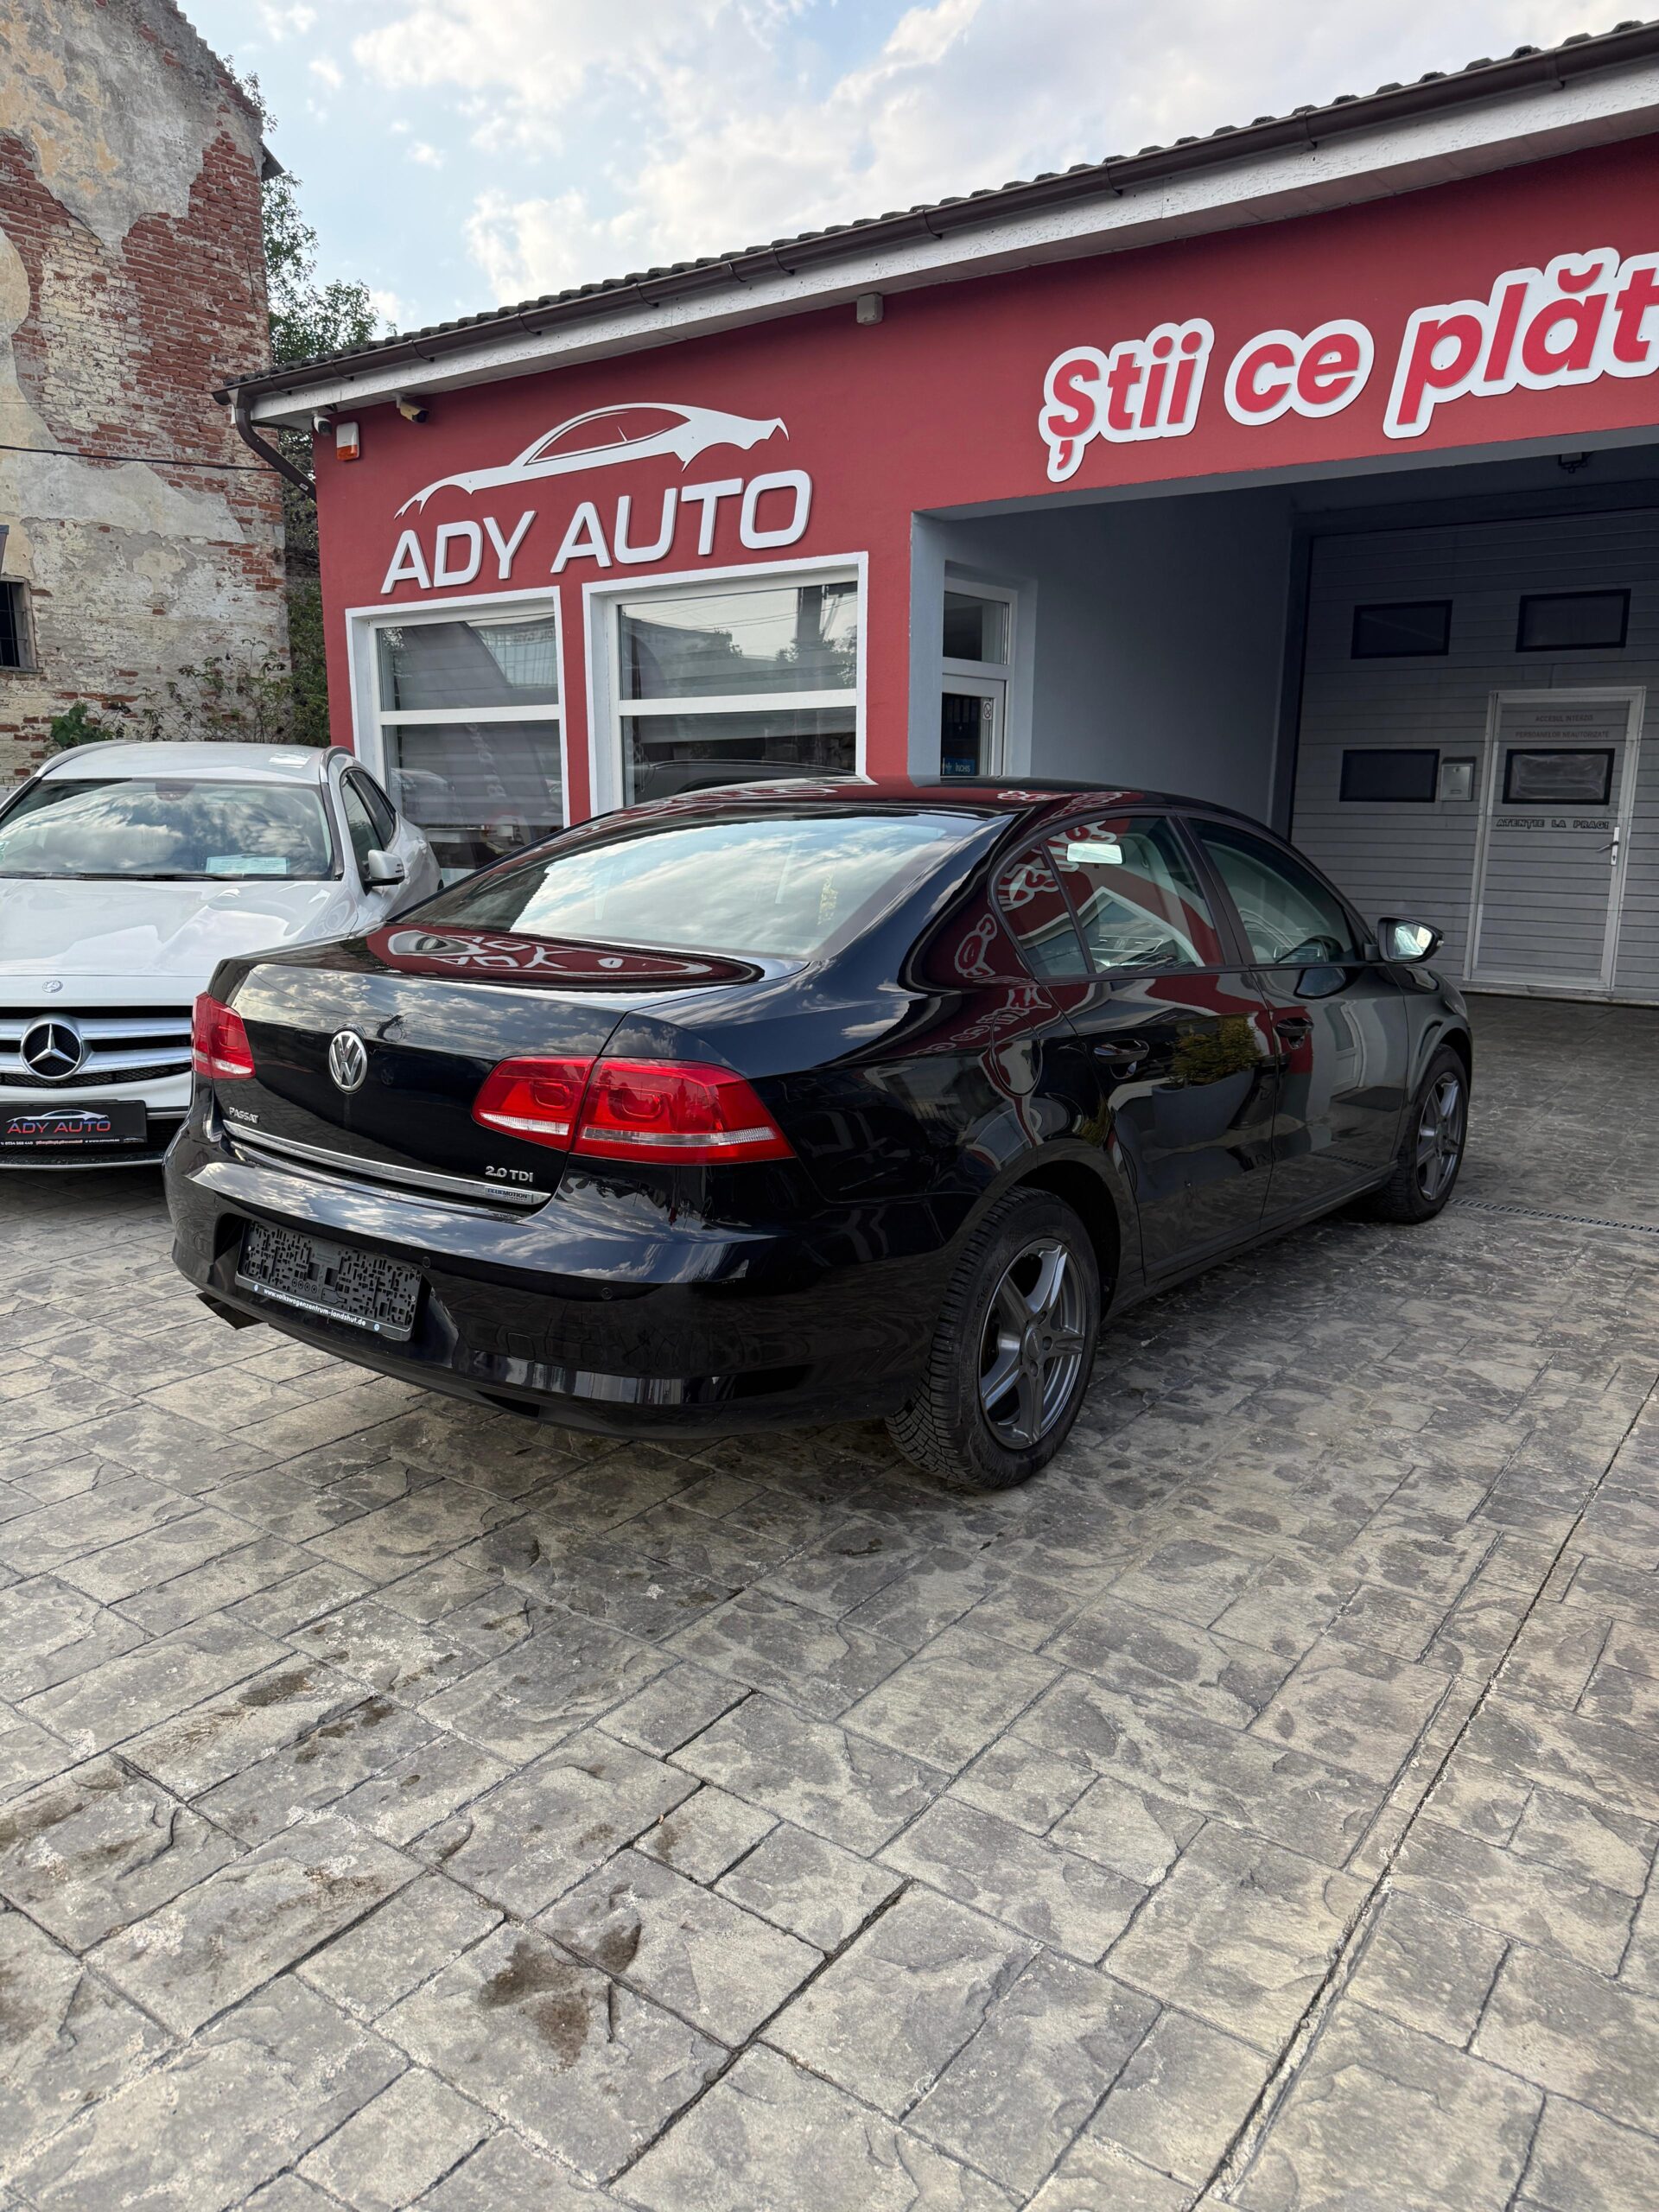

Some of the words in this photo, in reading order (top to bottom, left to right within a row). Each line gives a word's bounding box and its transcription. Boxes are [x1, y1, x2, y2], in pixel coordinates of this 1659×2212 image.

[1046, 328, 1205, 472] Știi
[1233, 330, 1363, 415] ce
[380, 510, 537, 594] ADY
[550, 469, 813, 574] AUTO
[1551, 819, 1567, 828] LA
[228, 1106, 259, 1124] PASSAT
[7, 1122, 49, 1134] ADY
[53, 1120, 111, 1134] AUTO
[485, 1165, 508, 1179] 2.0
[264, 1287, 366, 1327] www.volkswagenzentrum-landshut.de
